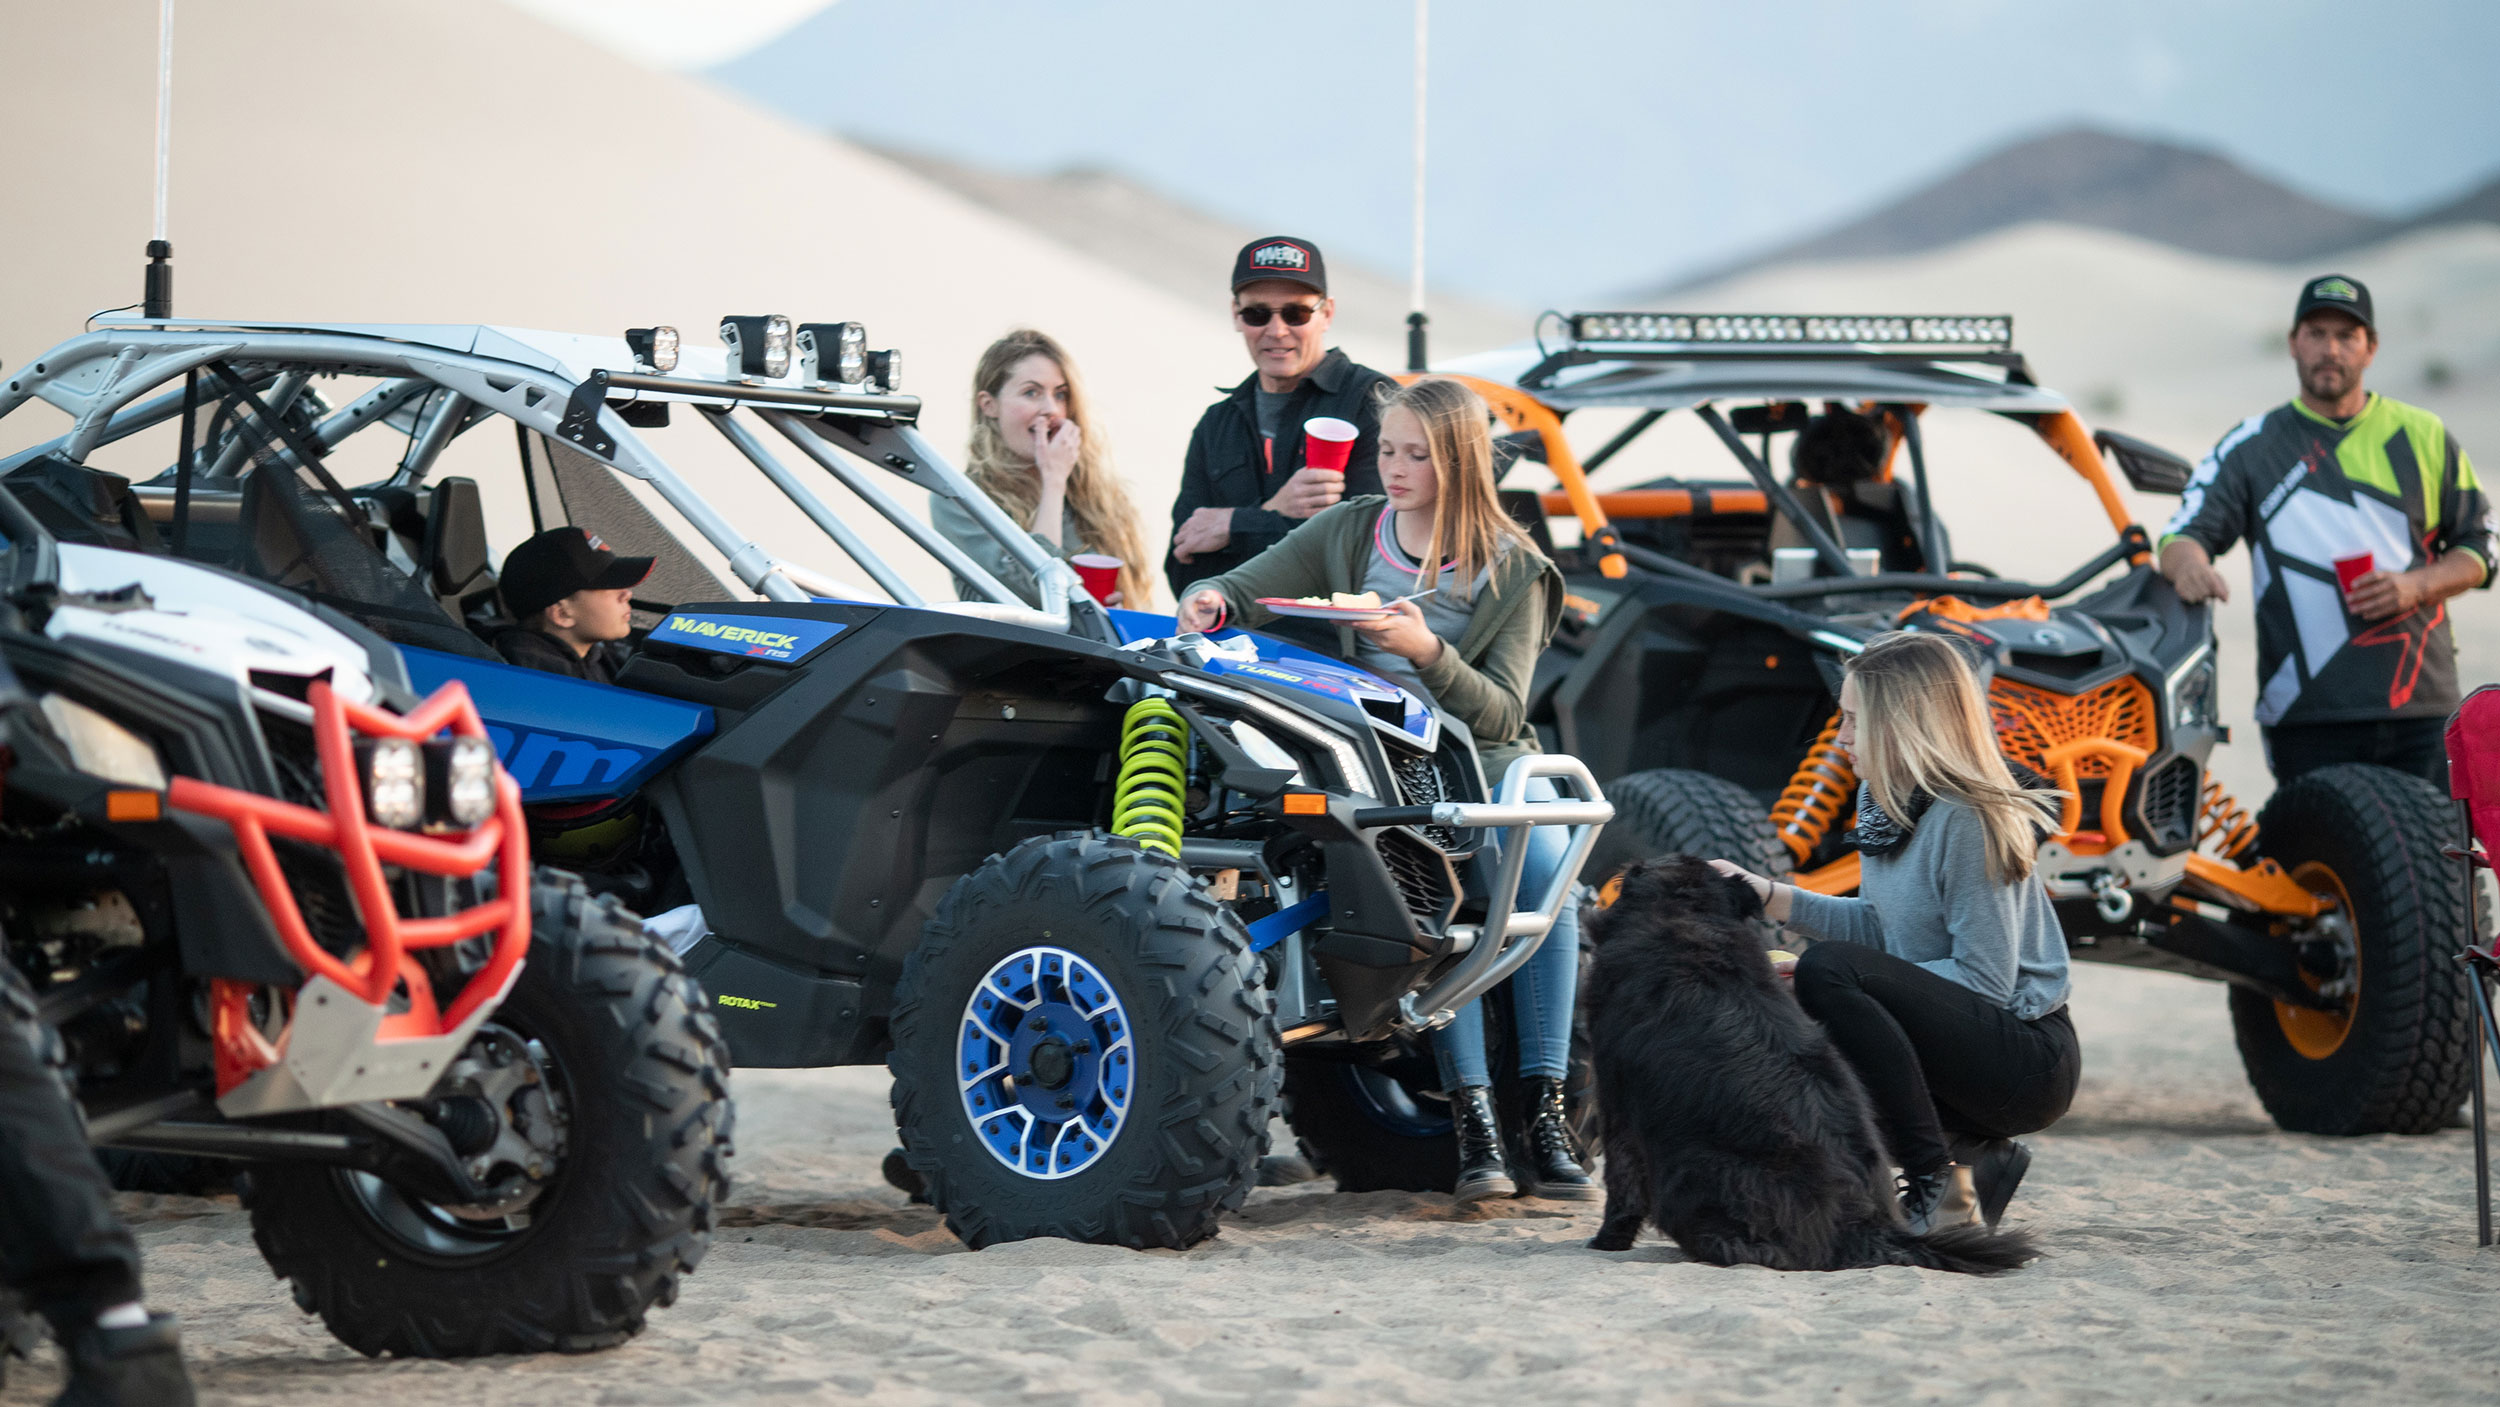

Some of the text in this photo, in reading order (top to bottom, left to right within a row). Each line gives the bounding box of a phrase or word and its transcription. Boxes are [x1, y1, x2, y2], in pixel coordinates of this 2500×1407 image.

[669, 616, 799, 649] MAVERICK
[1236, 664, 1303, 682] TURBO
[718, 995, 760, 1010] ROTAX
